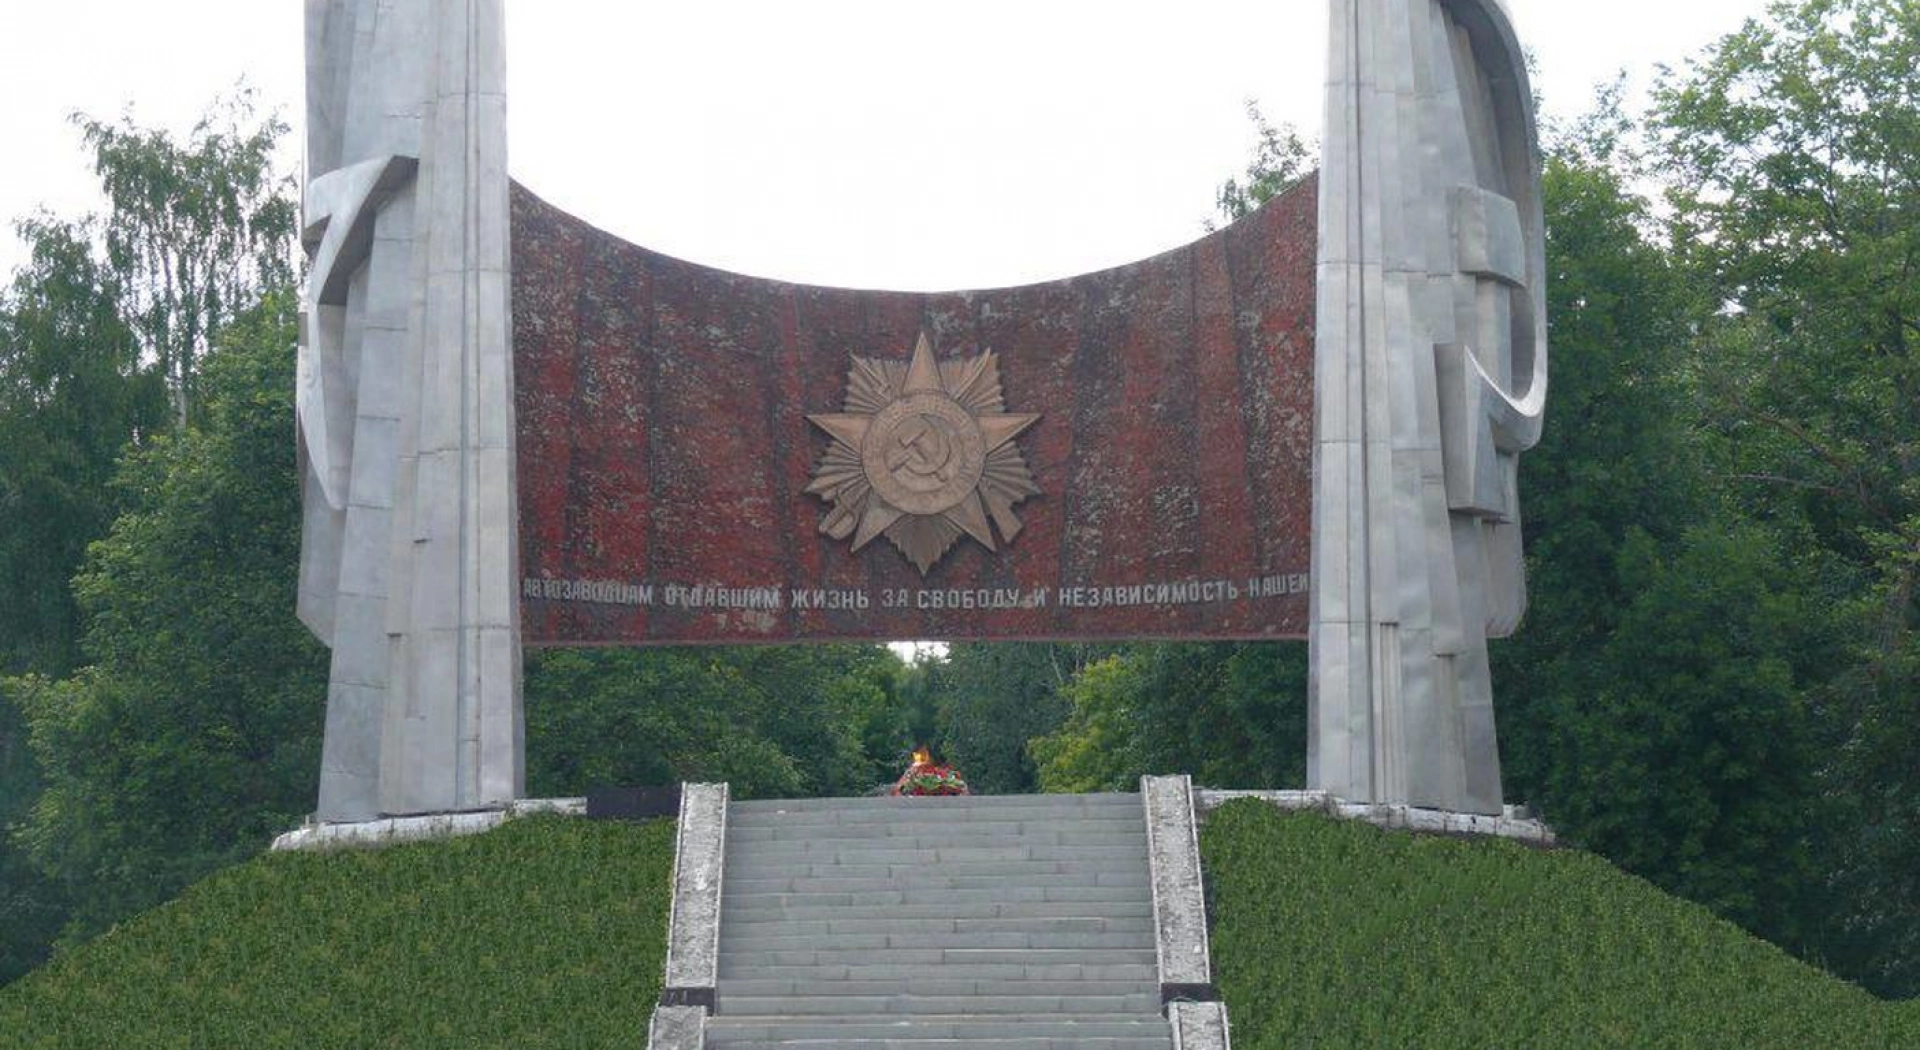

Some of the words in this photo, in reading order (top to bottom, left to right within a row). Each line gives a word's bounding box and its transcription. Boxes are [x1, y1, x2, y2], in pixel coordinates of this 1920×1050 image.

[665, 584, 781, 609] ОТДАВШИМ
[791, 589, 869, 609] ЖИЗНЬ
[882, 589, 909, 608] ЗА
[918, 590, 1020, 609] СВОБОДУ
[1034, 588, 1046, 607] И
[1059, 580, 1238, 607] НЕЗАВИСИМОСТЬ
